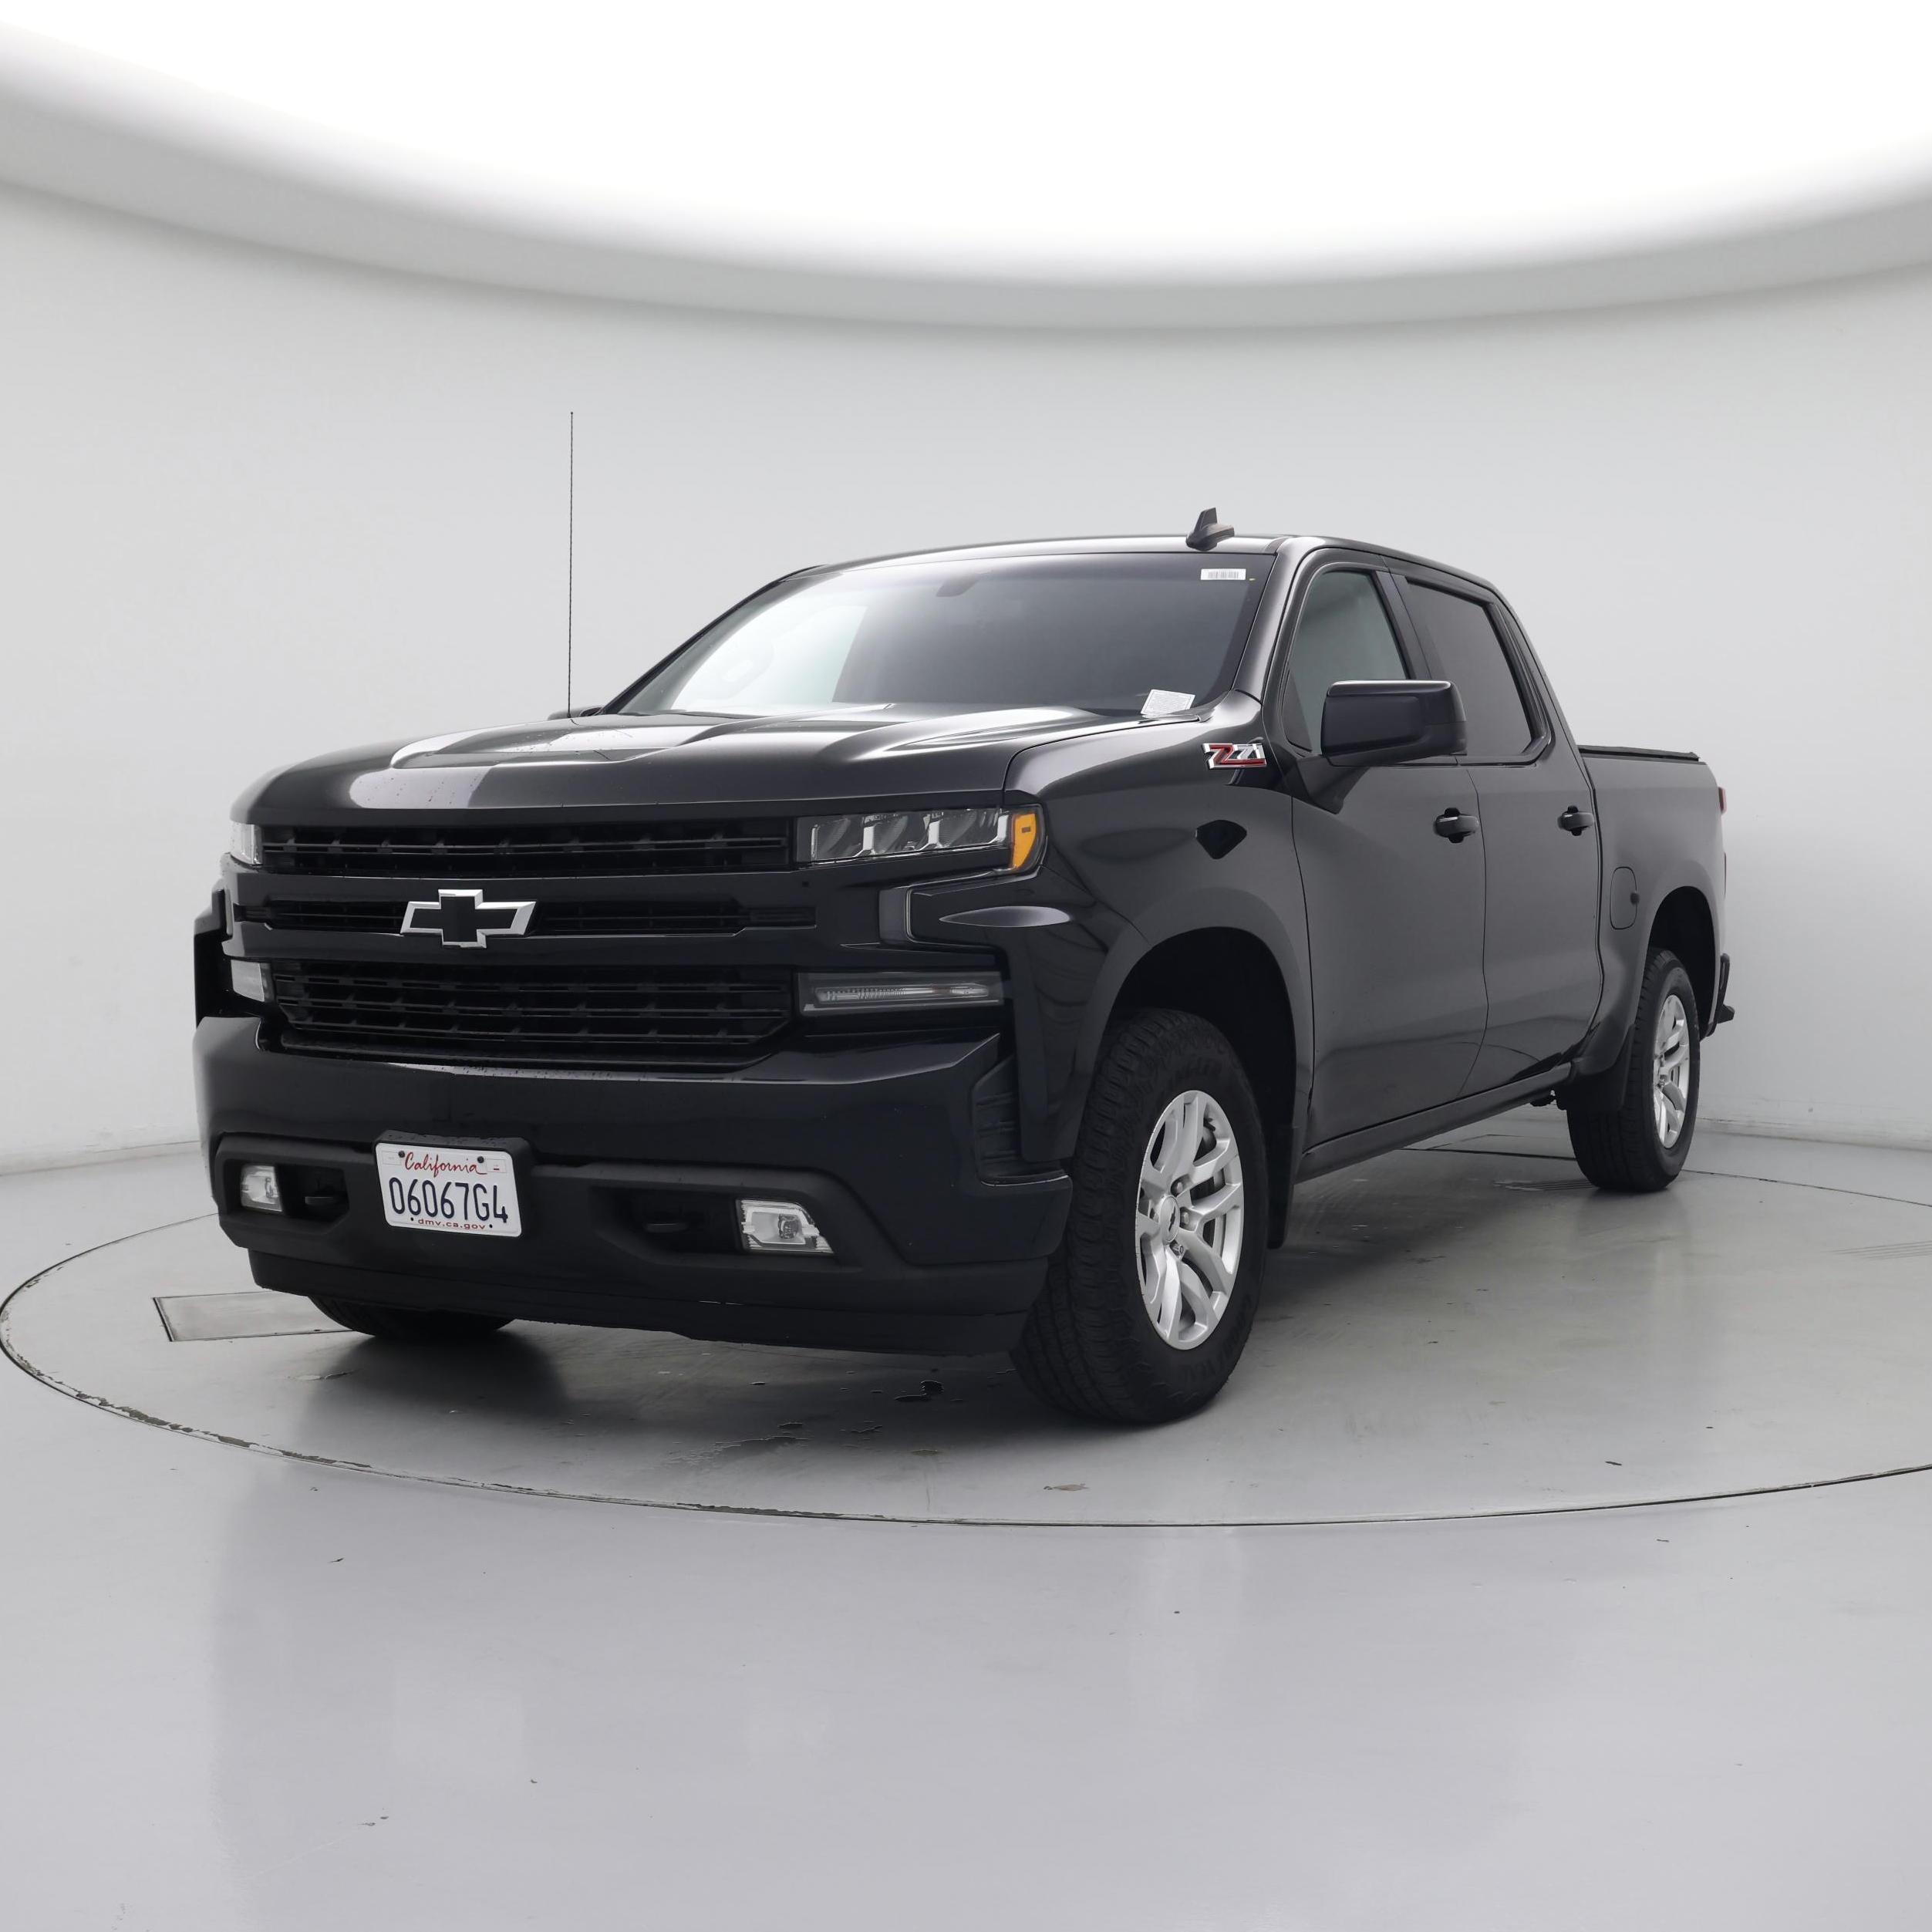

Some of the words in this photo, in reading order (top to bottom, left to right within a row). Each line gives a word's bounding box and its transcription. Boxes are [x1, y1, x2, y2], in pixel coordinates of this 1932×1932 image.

[1202, 743, 1266, 769] Z71
[404, 1151, 487, 1178] California
[389, 1177, 508, 1223] 06067G4
[417, 1218, 486, 1230] dmv.ca.gov
